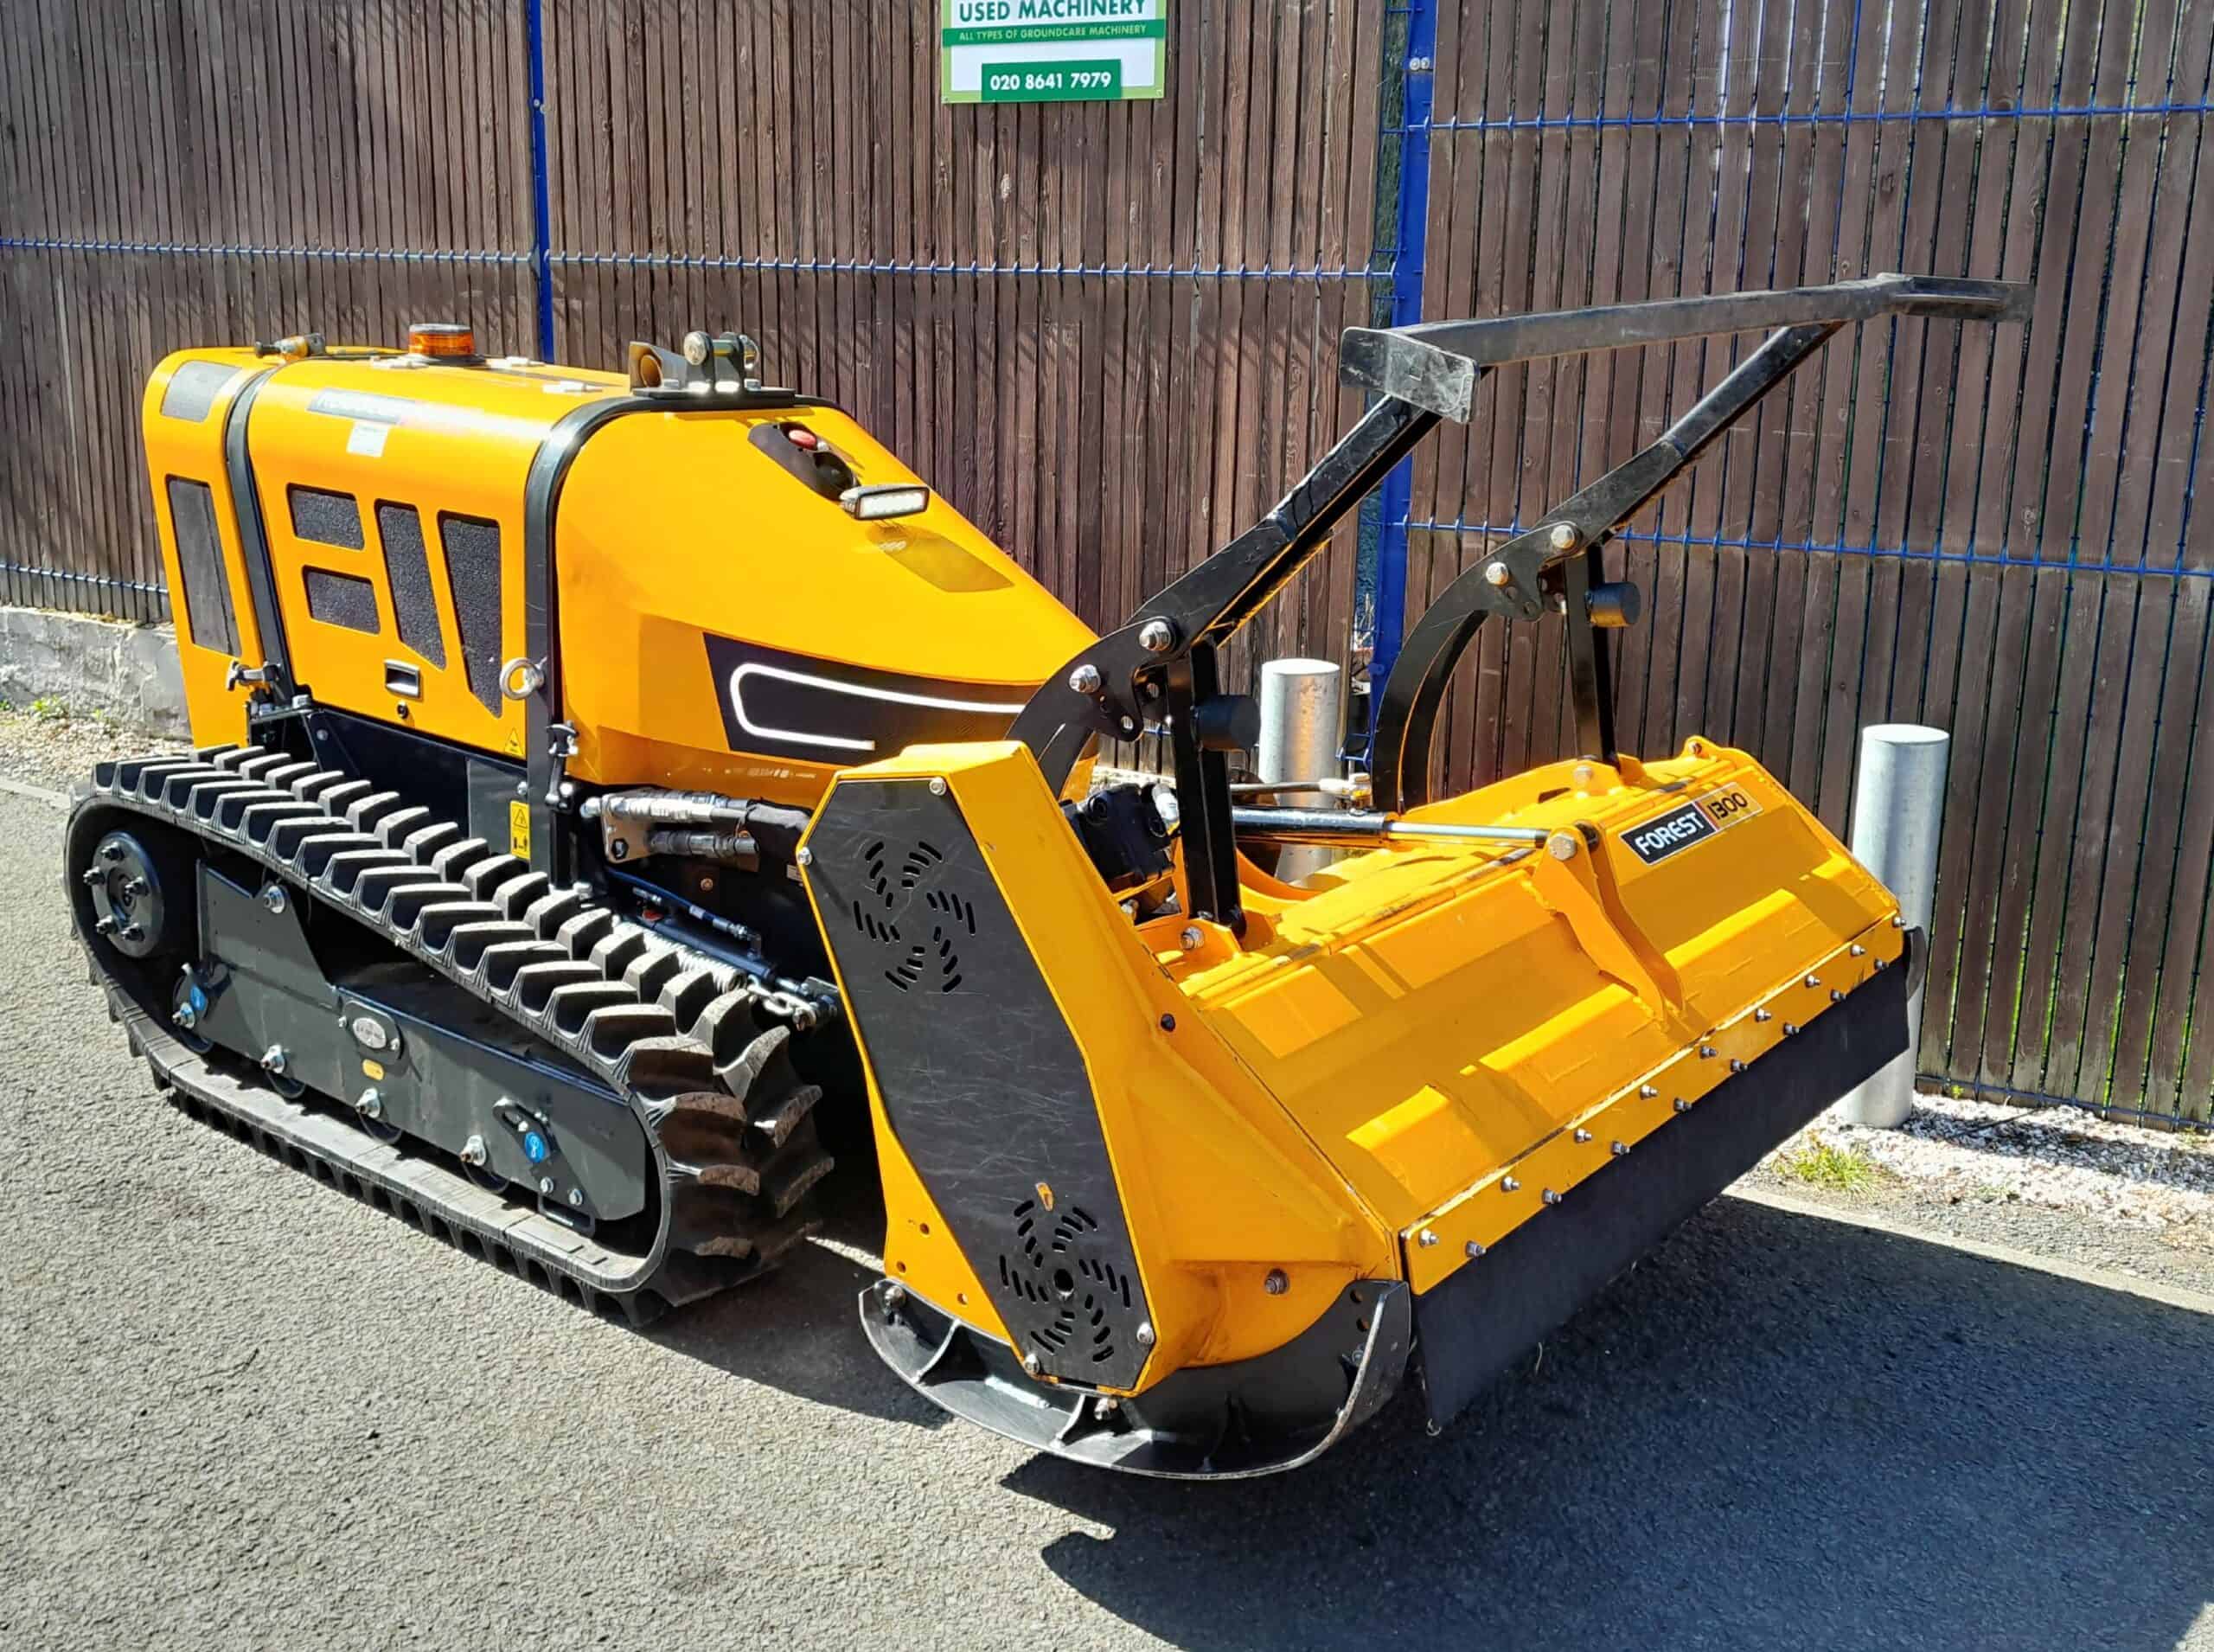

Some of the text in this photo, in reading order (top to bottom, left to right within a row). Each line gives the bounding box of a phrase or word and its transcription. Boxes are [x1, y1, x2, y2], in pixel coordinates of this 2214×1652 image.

[959, 0, 1145, 22] USED MACHINERY
[976, 31, 1002, 40] TYPES
[1006, 30, 1019, 39] OF
[1021, 28, 1086, 39] GROUNDCARE
[1089, 25, 1146, 35] MACHINERY
[990, 72, 1111, 91] 020 8641 7979
[1635, 792, 1748, 855] FOREST 1300
